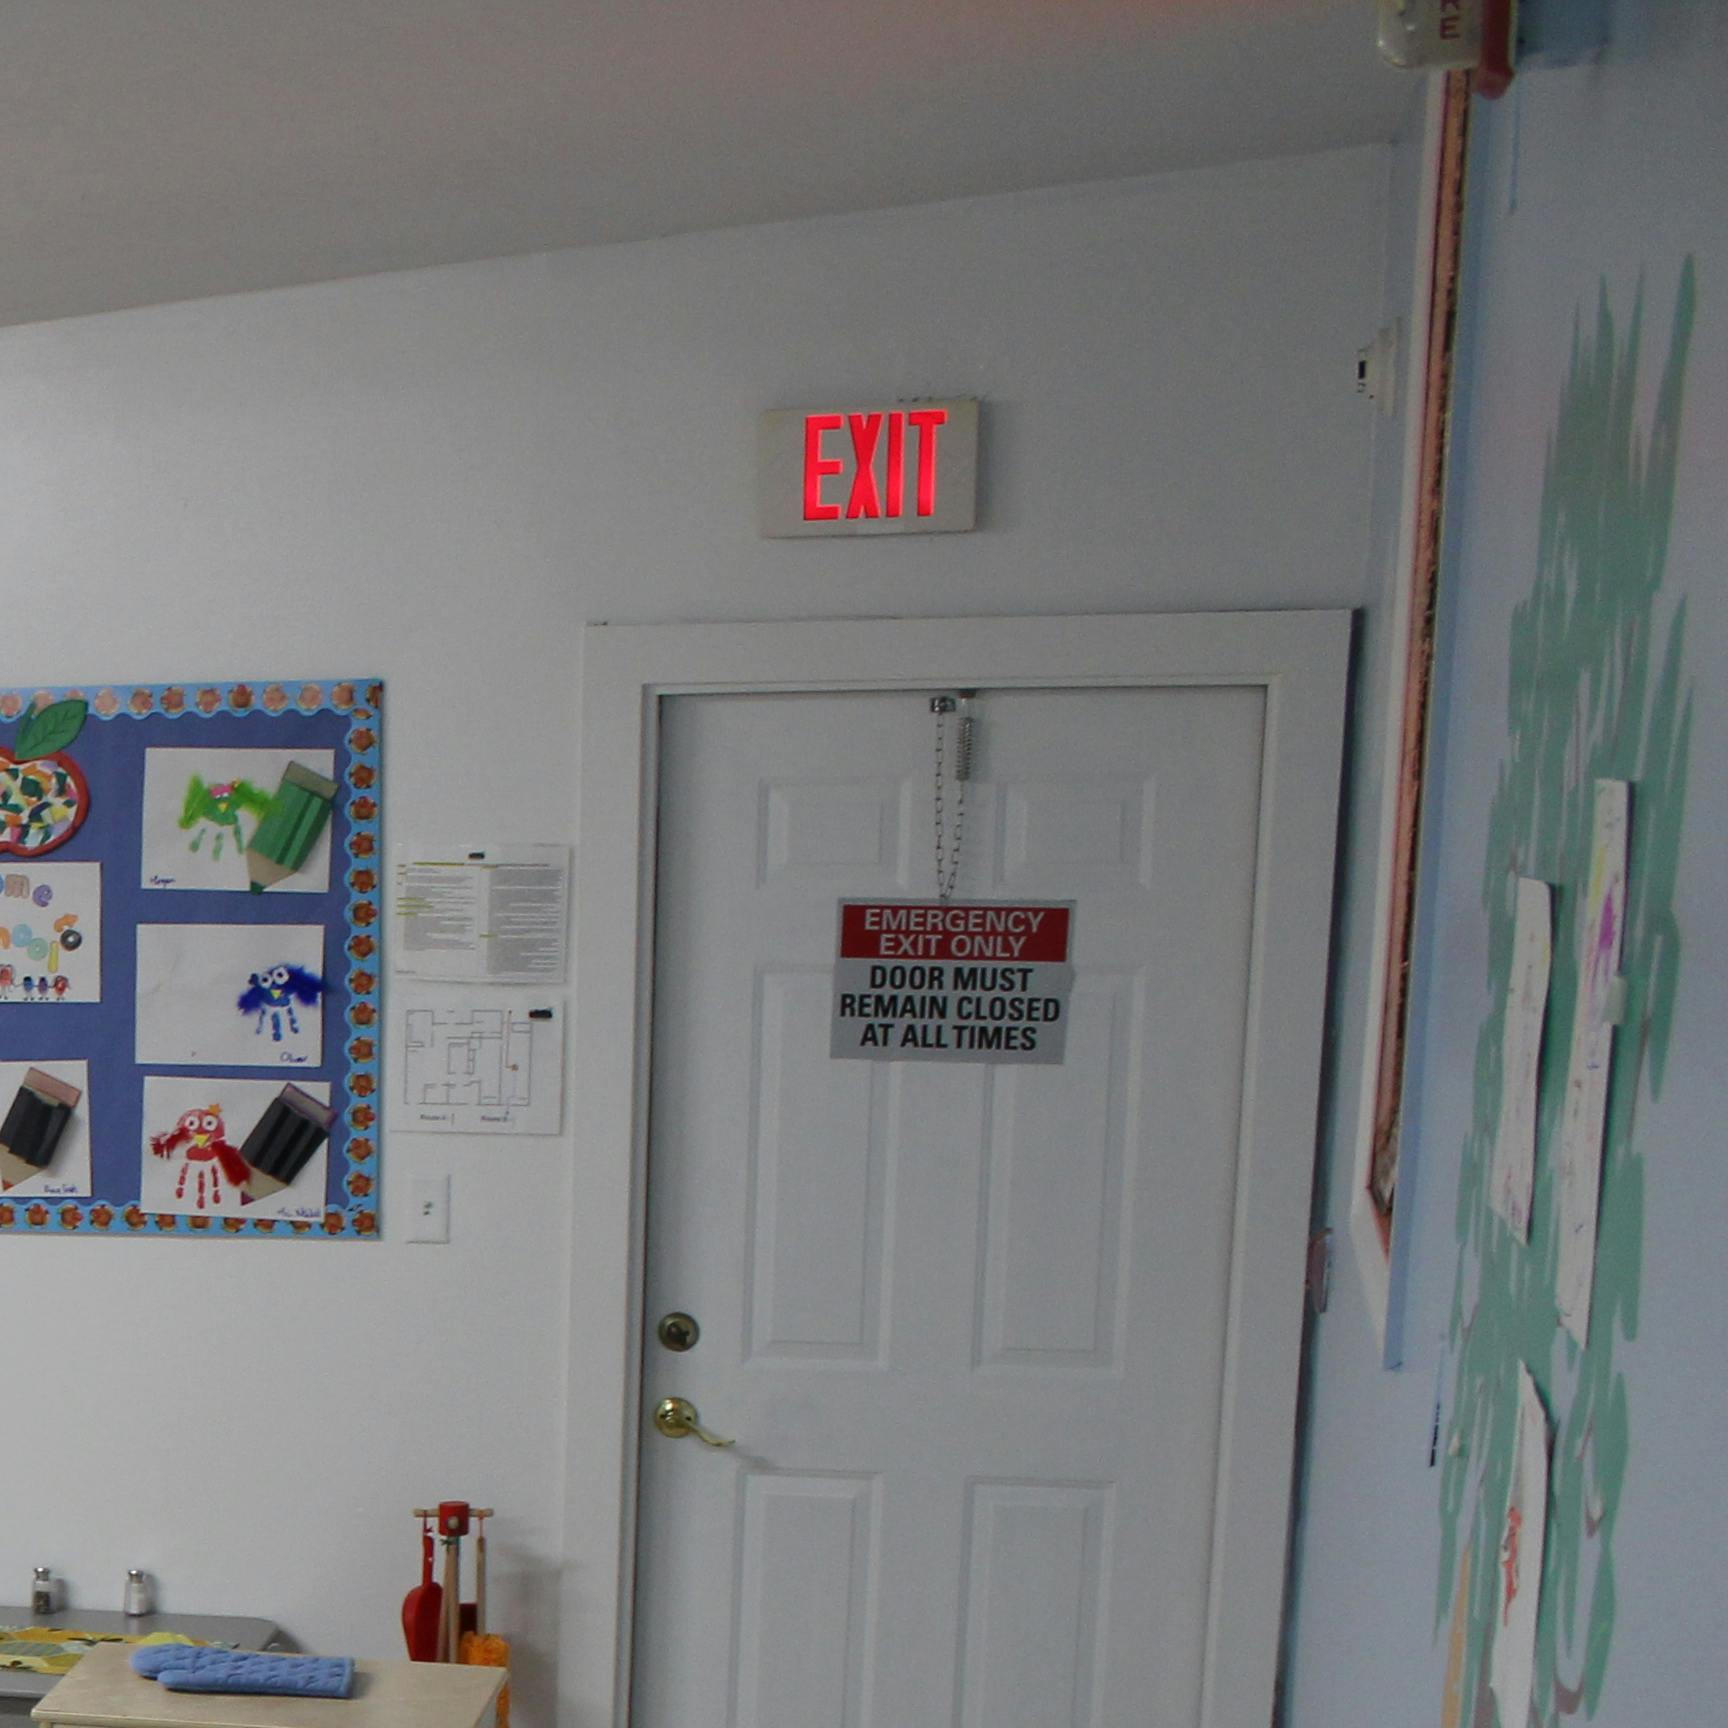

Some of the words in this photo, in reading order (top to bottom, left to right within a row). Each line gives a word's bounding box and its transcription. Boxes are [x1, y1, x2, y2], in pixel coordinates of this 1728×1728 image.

[802, 409, 949, 521] EXIT
[862, 908, 1046, 934] EMERGENCY
[877, 933, 943, 957] EXIT
[950, 934, 1027, 959] ONLY
[869, 964, 947, 991] DOOR
[952, 966, 1032, 992] MUST
[838, 994, 953, 1020] REMAIN
[956, 996, 1061, 1023] CLOSED
[859, 1023, 897, 1048] AT
[901, 1023, 947, 1049] ALL
[950, 1025, 1037, 1052] TIMES
